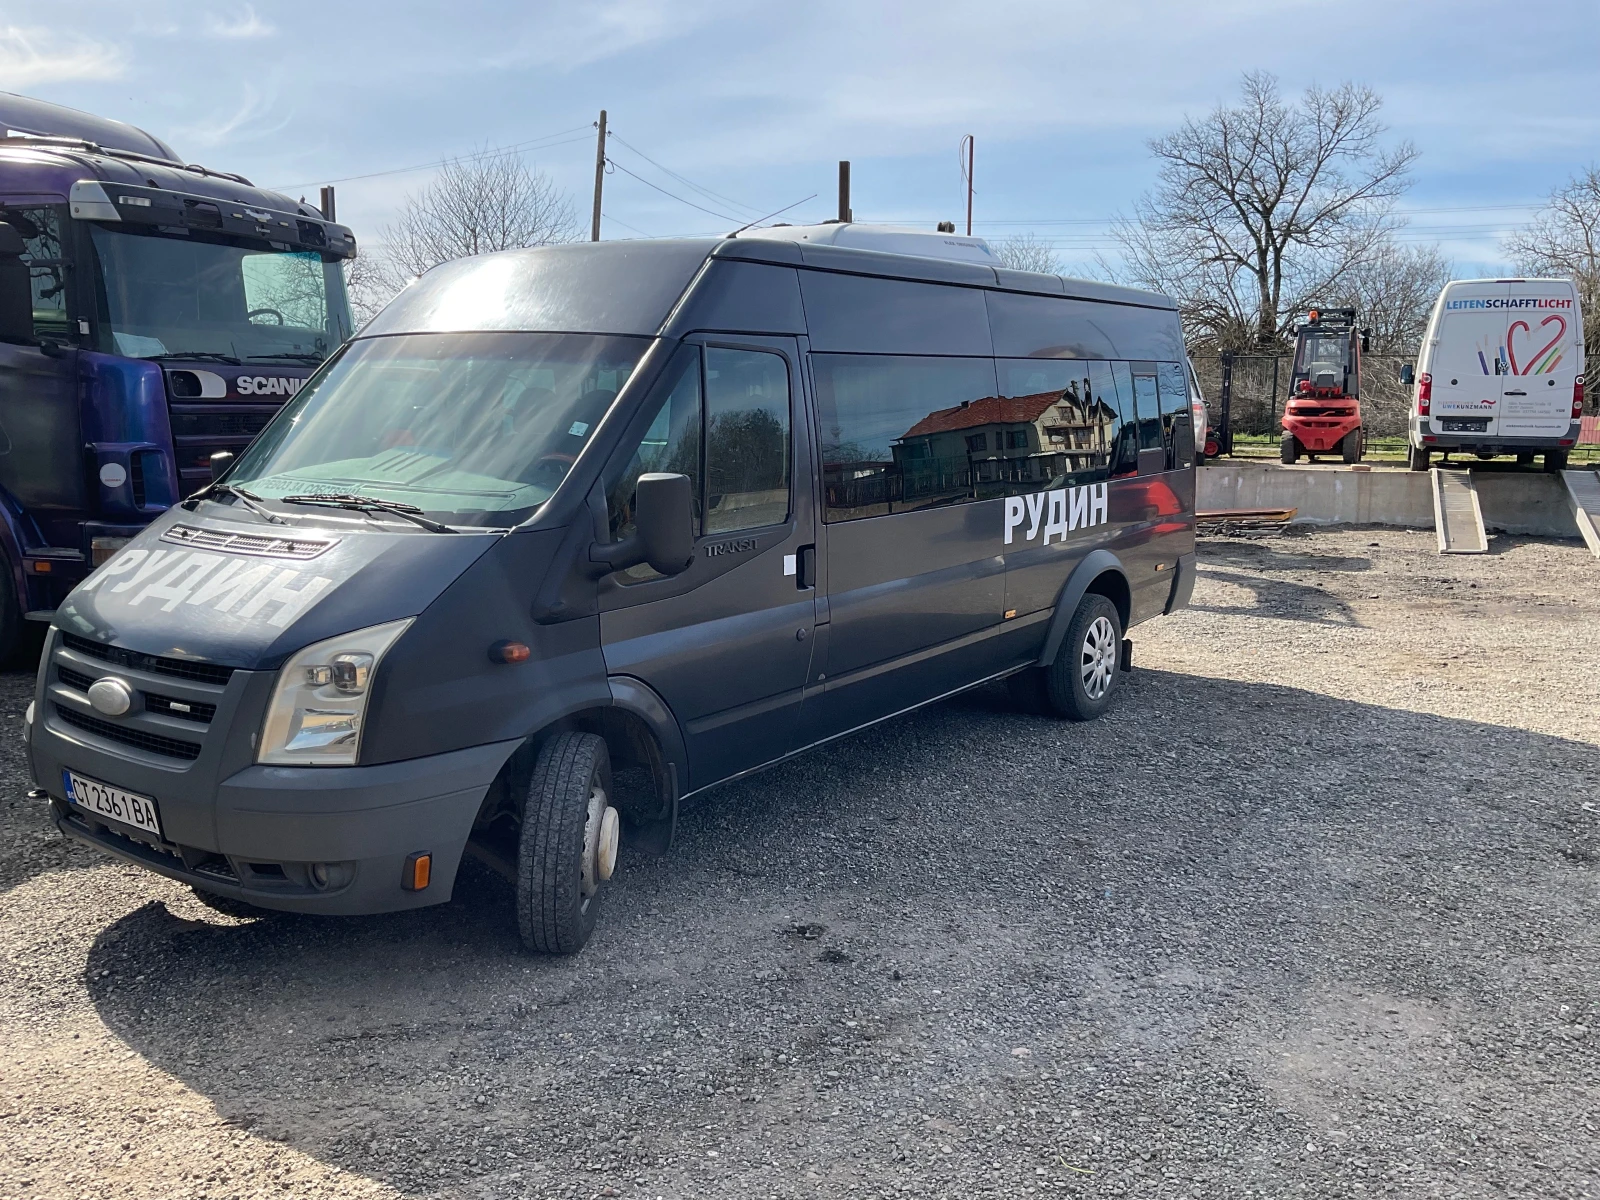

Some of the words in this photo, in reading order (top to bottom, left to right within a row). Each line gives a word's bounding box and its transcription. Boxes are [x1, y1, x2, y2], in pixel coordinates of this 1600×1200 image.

[1446, 298, 1573, 310] LEITENSCHAFFTLICHT
[1003, 482, 1109, 546] РУДИН
[705, 538, 760, 558] TRANSIT
[82, 549, 333, 629] РУДИН
[92, 786, 131, 821] 2361
